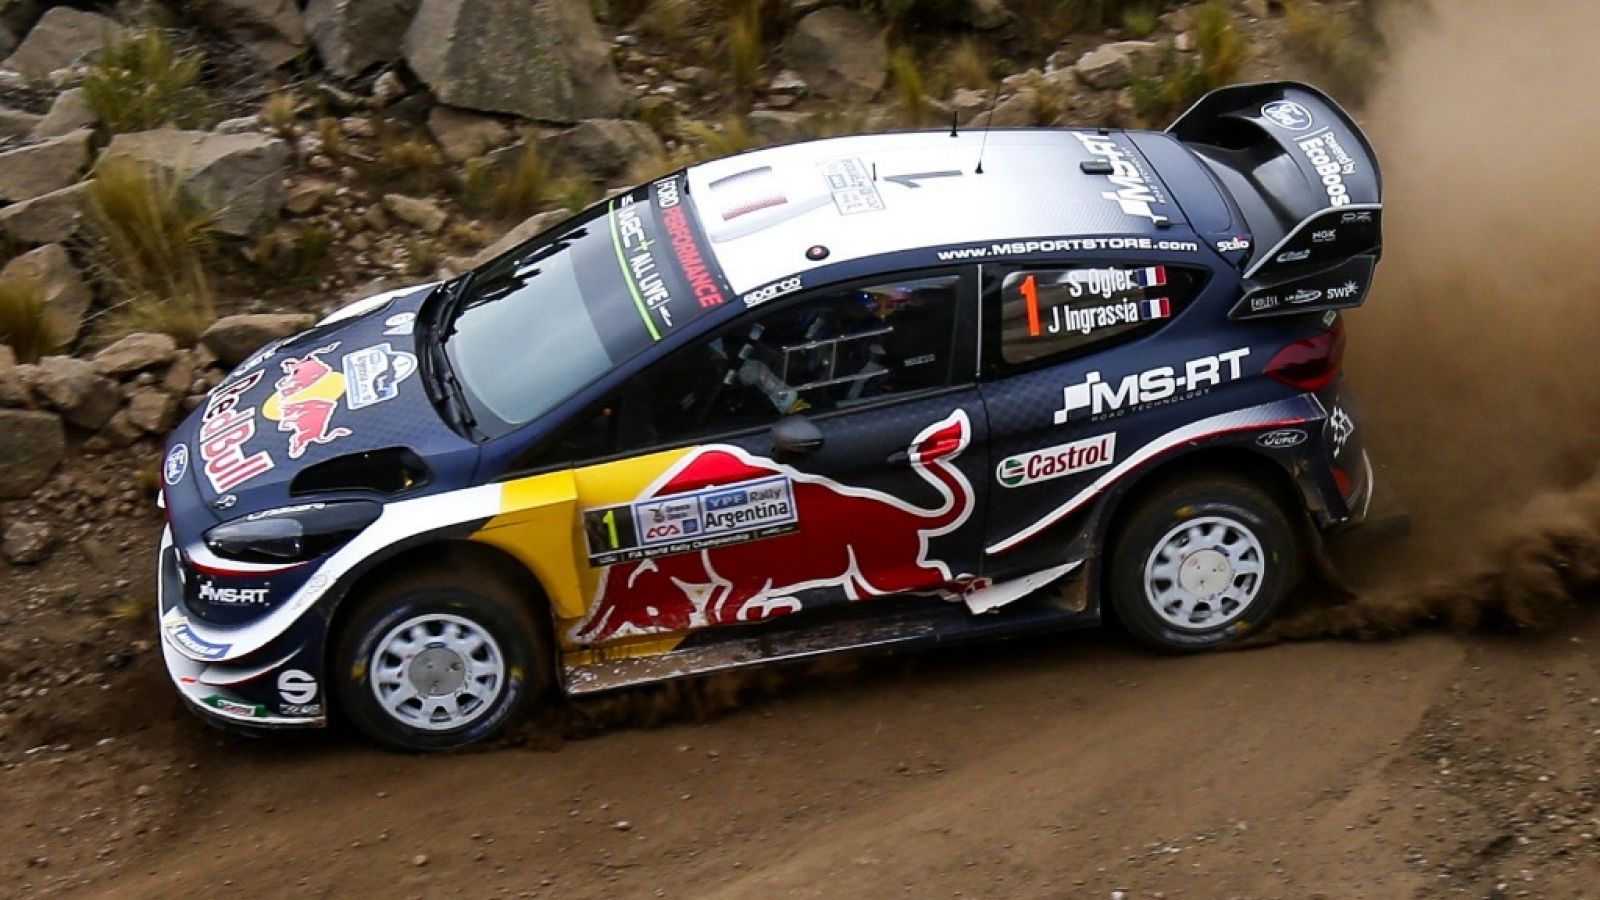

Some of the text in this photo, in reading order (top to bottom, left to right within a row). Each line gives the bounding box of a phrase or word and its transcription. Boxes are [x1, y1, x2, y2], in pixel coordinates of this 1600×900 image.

[1321, 132, 1356, 174] Powered by
[883, 169, 963, 189] 1
[1299, 138, 1350, 207] EcoBoos
[657, 180, 724, 308] FORD PERFORMANCE
[938, 238, 1197, 260] www.MSPORTSTORE.com
[630, 252, 655, 279] ALL
[1069, 266, 1133, 298] S Ogier
[639, 272, 669, 306] LIVE
[743, 277, 803, 308] sparco
[1020, 274, 1040, 336] 1
[1048, 298, 1138, 334] J Ingrassia
[201, 370, 265, 441] Red
[1261, 431, 1303, 446] Ford
[203, 421, 274, 493] Bull
[1028, 438, 1109, 479] Castrol
[749, 486, 782, 503] Rally
[602, 510, 619, 549] 1
[705, 501, 789, 529] Argentina
